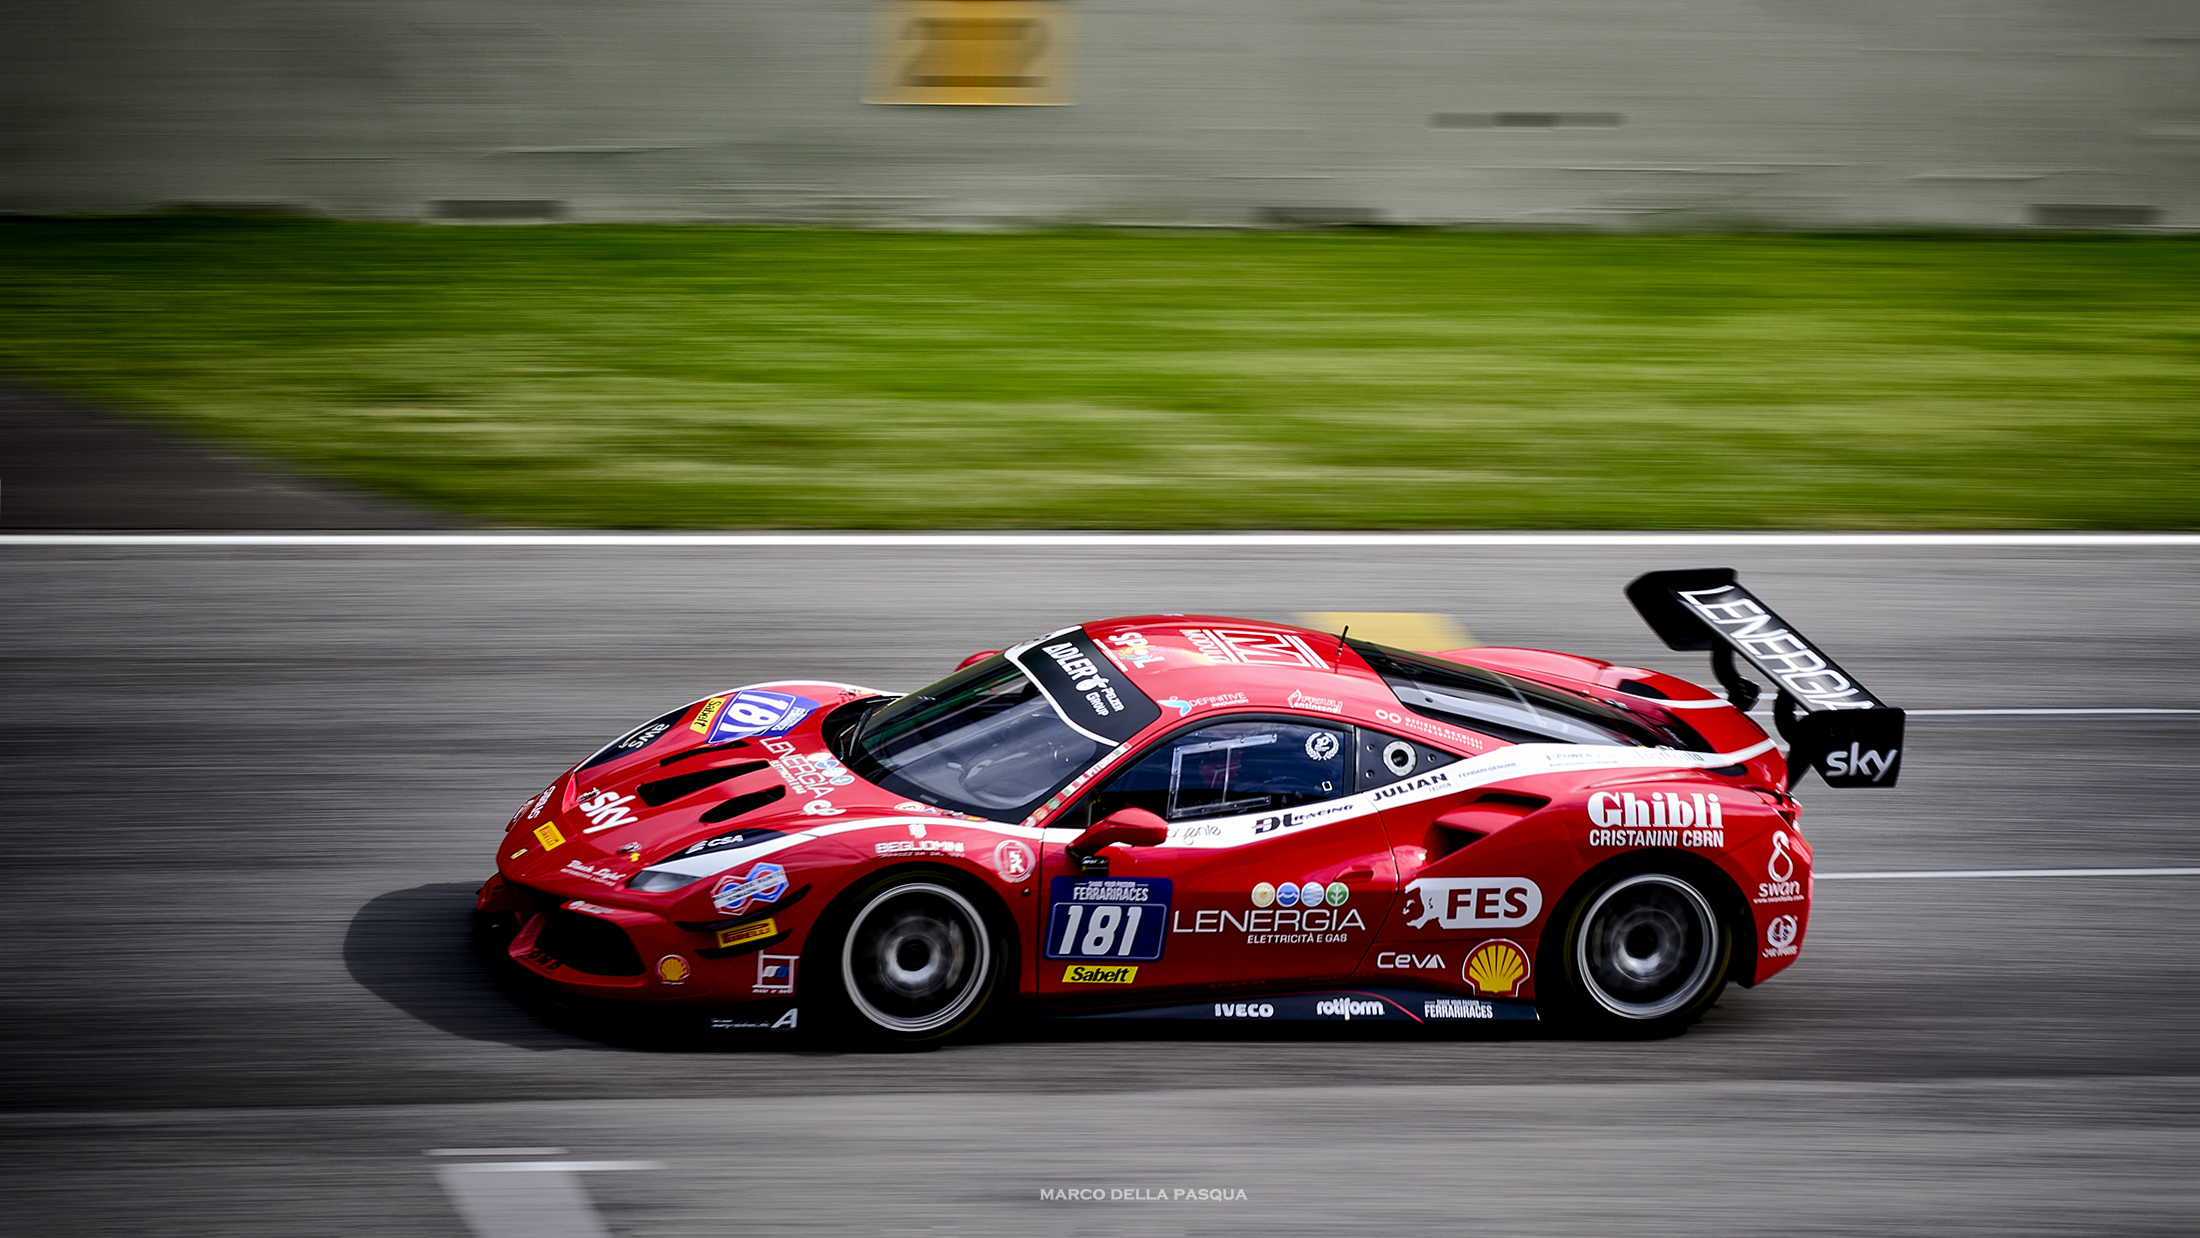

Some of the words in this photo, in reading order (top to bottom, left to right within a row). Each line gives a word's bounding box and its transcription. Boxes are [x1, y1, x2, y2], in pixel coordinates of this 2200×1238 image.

[1677, 584, 1875, 711] LENERGI
[1042, 642, 1098, 680] ADLER
[1085, 691, 1110, 716] GROUP
[1101, 687, 1124, 712] PELZER
[1190, 692, 1247, 707] DEFINITIVE
[694, 701, 721, 728] Sabelt
[719, 693, 790, 733] 181
[759, 736, 835, 798] LENERGIA
[1825, 742, 1898, 782] sky
[1373, 774, 1448, 801] JULIAN
[579, 792, 638, 834] sky
[1588, 791, 1724, 829] Ghibli
[1589, 829, 1678, 847] CRISTANINI
[1682, 831, 1724, 848] CBRN
[1073, 887, 1149, 902] FERRARIRACES
[1758, 881, 1800, 897] swan
[1446, 887, 1529, 920] FES
[1058, 905, 1142, 956] 181
[1173, 908, 1366, 933] LENERGIA
[1247, 932, 1315, 944] ELETTRICITÀ
[1316, 934, 1323, 943] E
[1328, 933, 1348, 943] GAS
[1070, 966, 1130, 983] Sabelt
[1214, 1003, 1274, 1017] IVECO
[1316, 997, 1385, 1021] rotiform
[1424, 1004, 1494, 1019] FERRARIRACES
